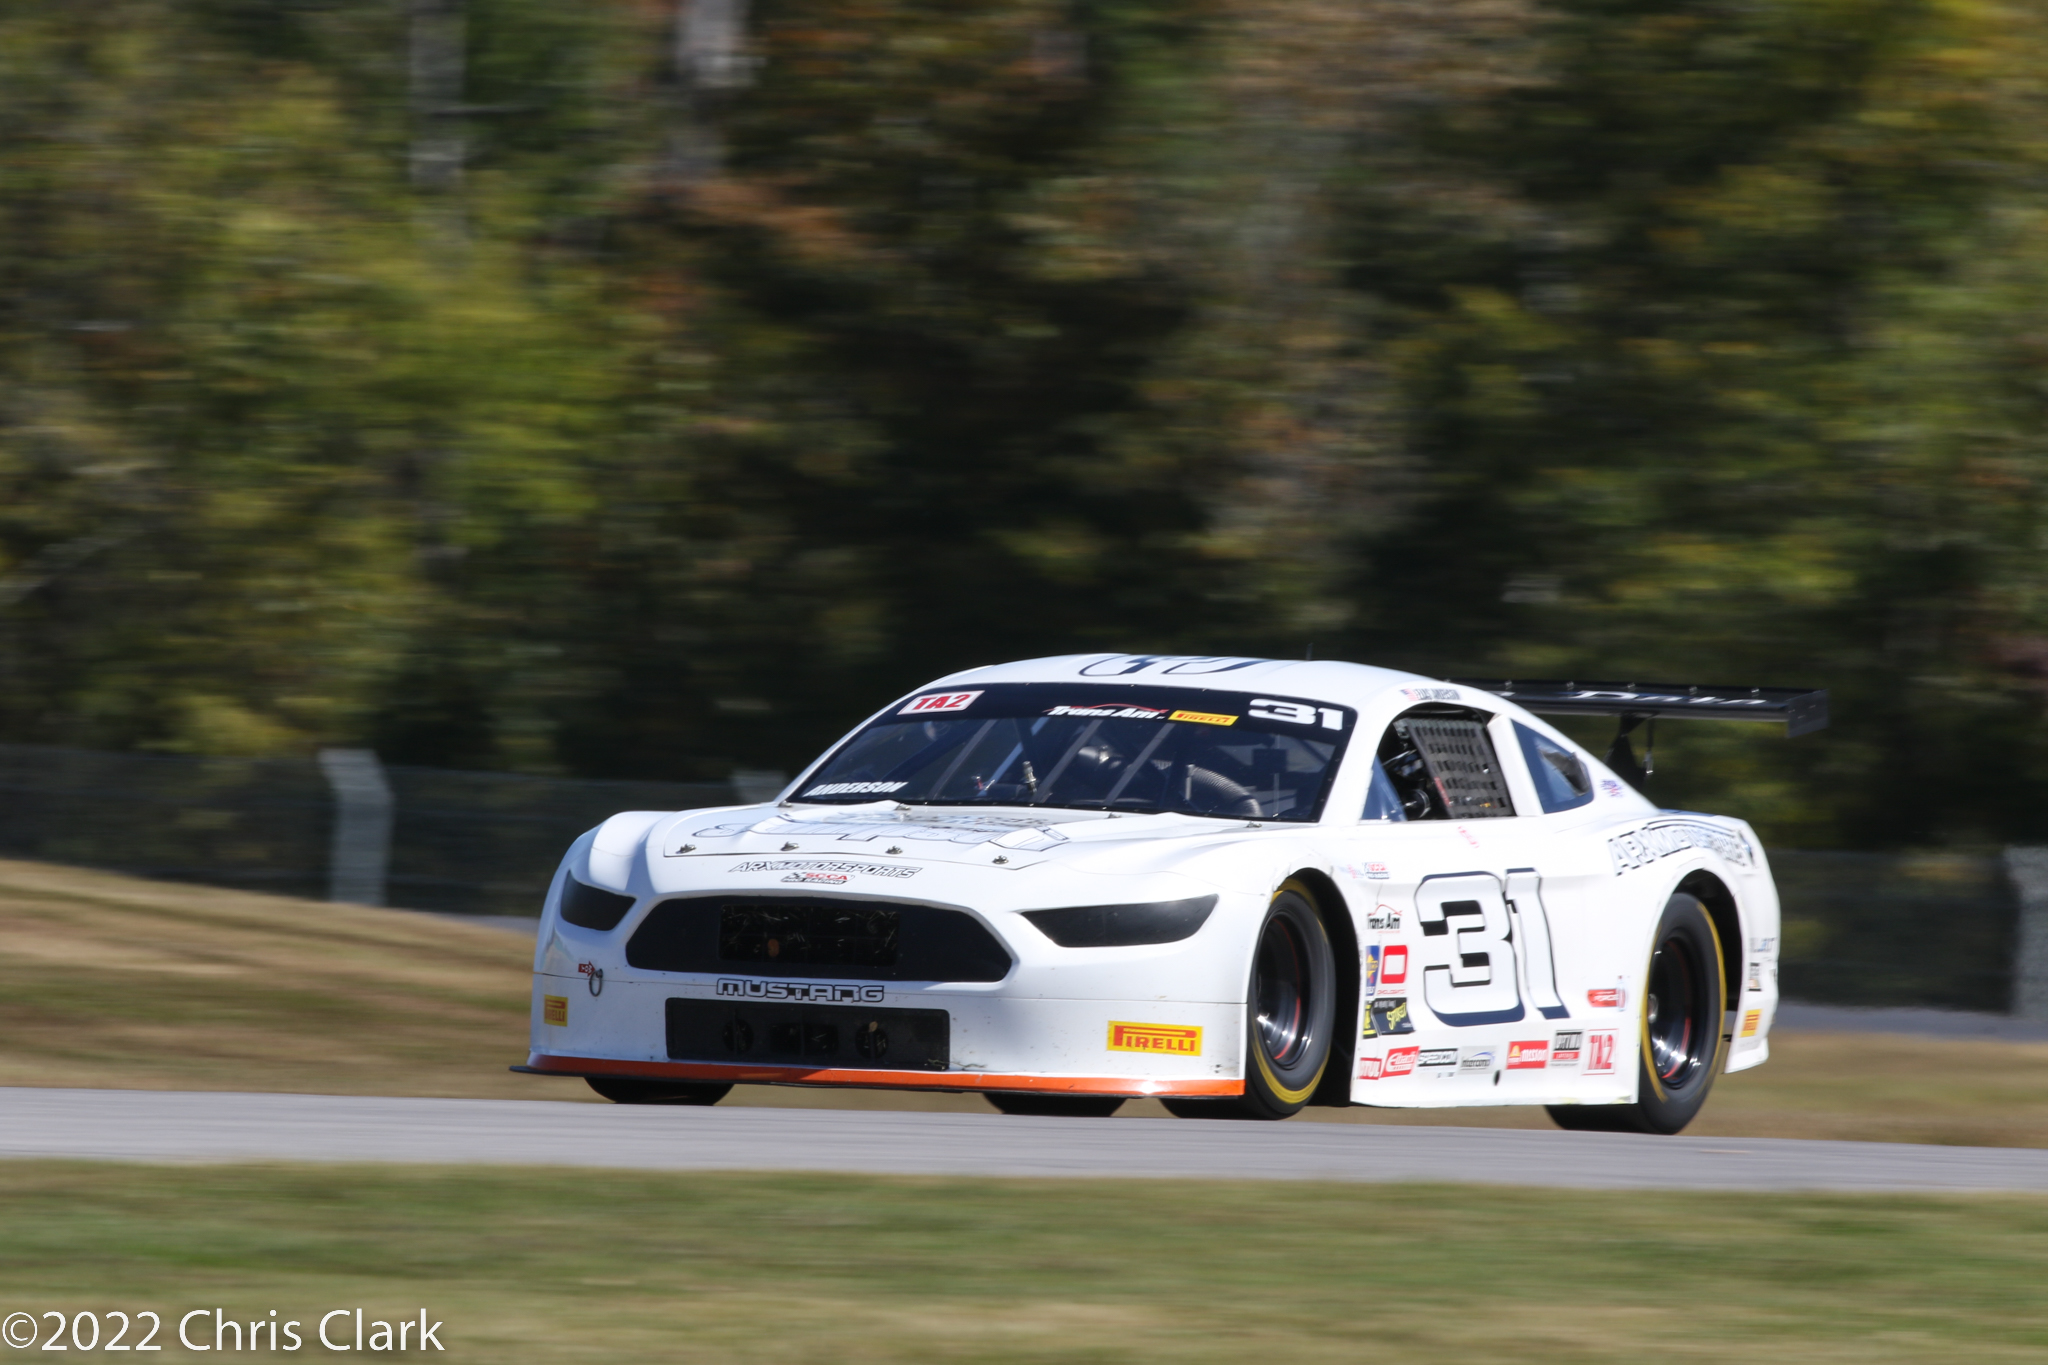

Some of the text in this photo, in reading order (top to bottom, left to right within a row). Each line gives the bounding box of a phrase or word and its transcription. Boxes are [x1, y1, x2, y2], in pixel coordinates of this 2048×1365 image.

[912, 694, 971, 710] TA2
[1047, 705, 1161, 719] Trans Am
[1175, 713, 1231, 724] PIRELLI
[1248, 698, 1343, 731] 31
[802, 781, 909, 797] ANDERSON
[805, 872, 848, 881] SCCA
[1414, 867, 1571, 1028] 31
[716, 977, 885, 1003] MUSTANG
[1113, 1025, 1197, 1052] PIRELLI
